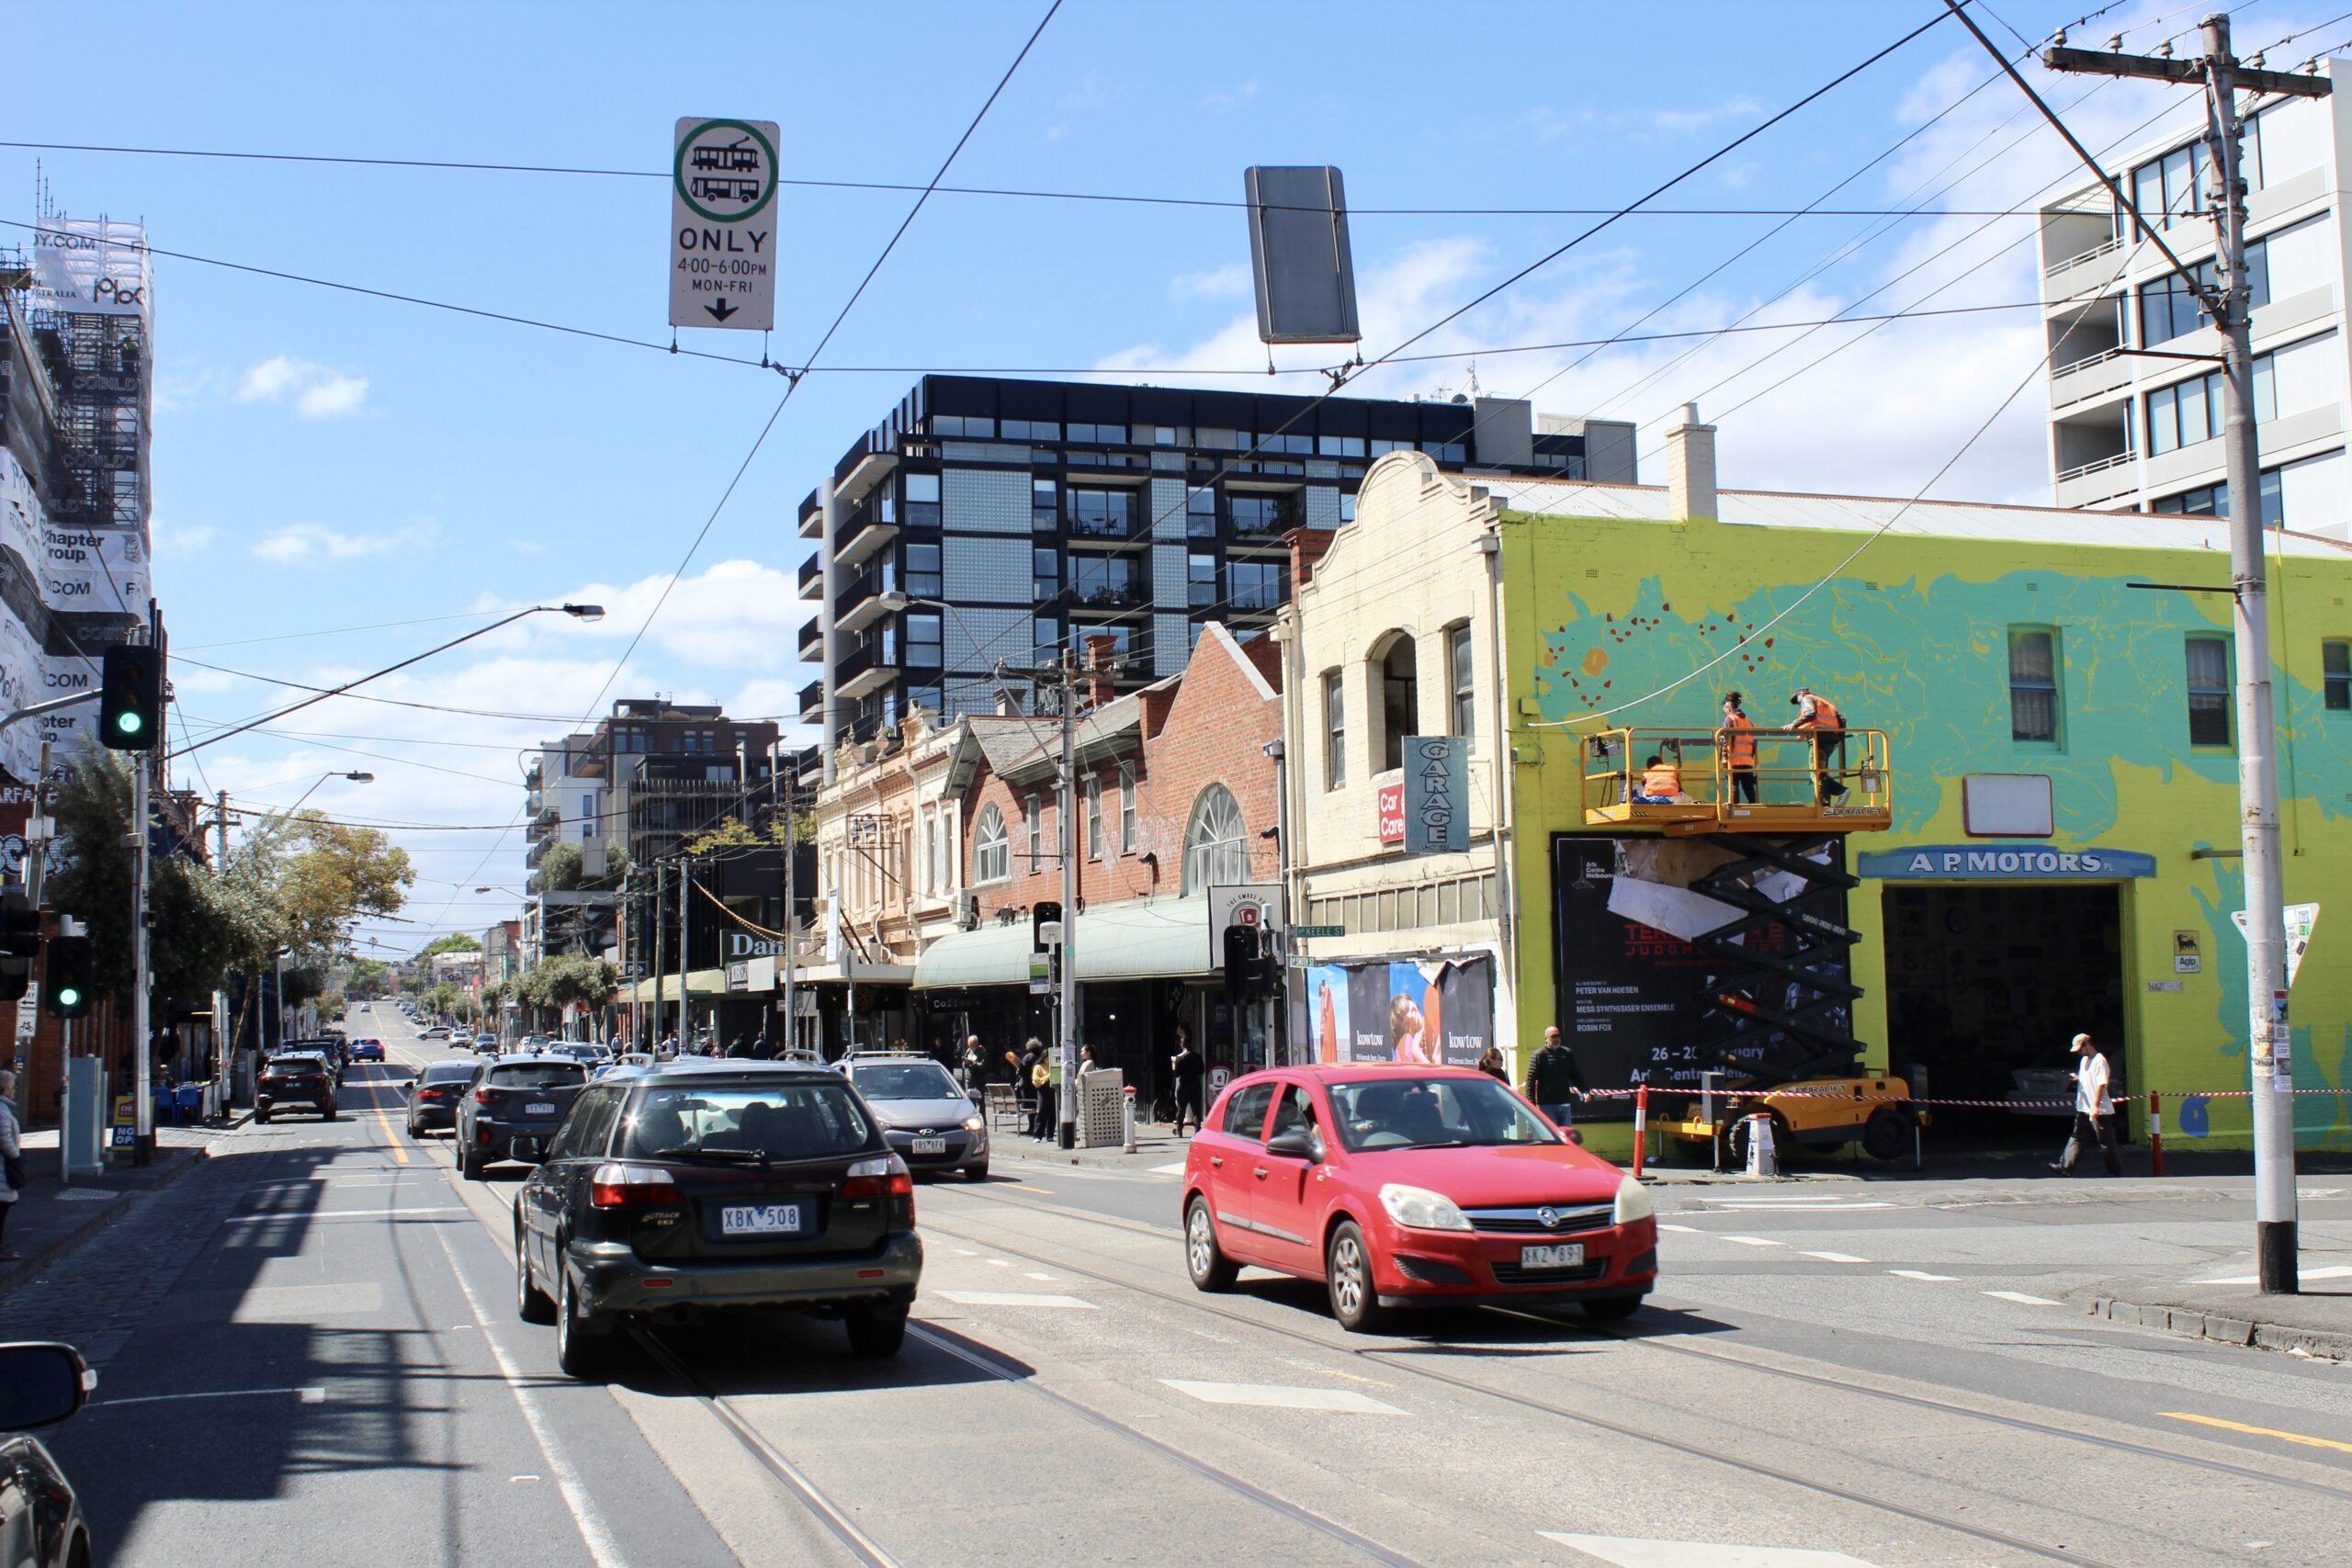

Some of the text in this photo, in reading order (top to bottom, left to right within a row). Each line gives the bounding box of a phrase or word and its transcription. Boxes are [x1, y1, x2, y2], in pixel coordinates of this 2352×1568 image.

[679, 228, 767, 253] ONLY
[692, 279, 752, 293] MON-FRI
[1419, 741, 1453, 843] GARAGE
[1380, 793, 1397, 813] Car
[1833, 808, 1882, 817] DURALIFT
[1381, 815, 1404, 837] Care
[1907, 853, 1934, 872] A
[1967, 852, 2101, 872] MOTORS
[1306, 927, 1331, 936] KEELE
[1334, 927, 1344, 935] ST
[2180, 957, 2196, 966] Agip
[1596, 1004, 1640, 1012] SYNTHESISER
[1641, 1003, 1675, 1011] ENSEMBLE
[1357, 1030, 1384, 1045] kowtow
[1449, 1031, 1482, 1049] kowtow
[1652, 1047, 1668, 1060] 26
[725, 1208, 797, 1227] XBK 508
